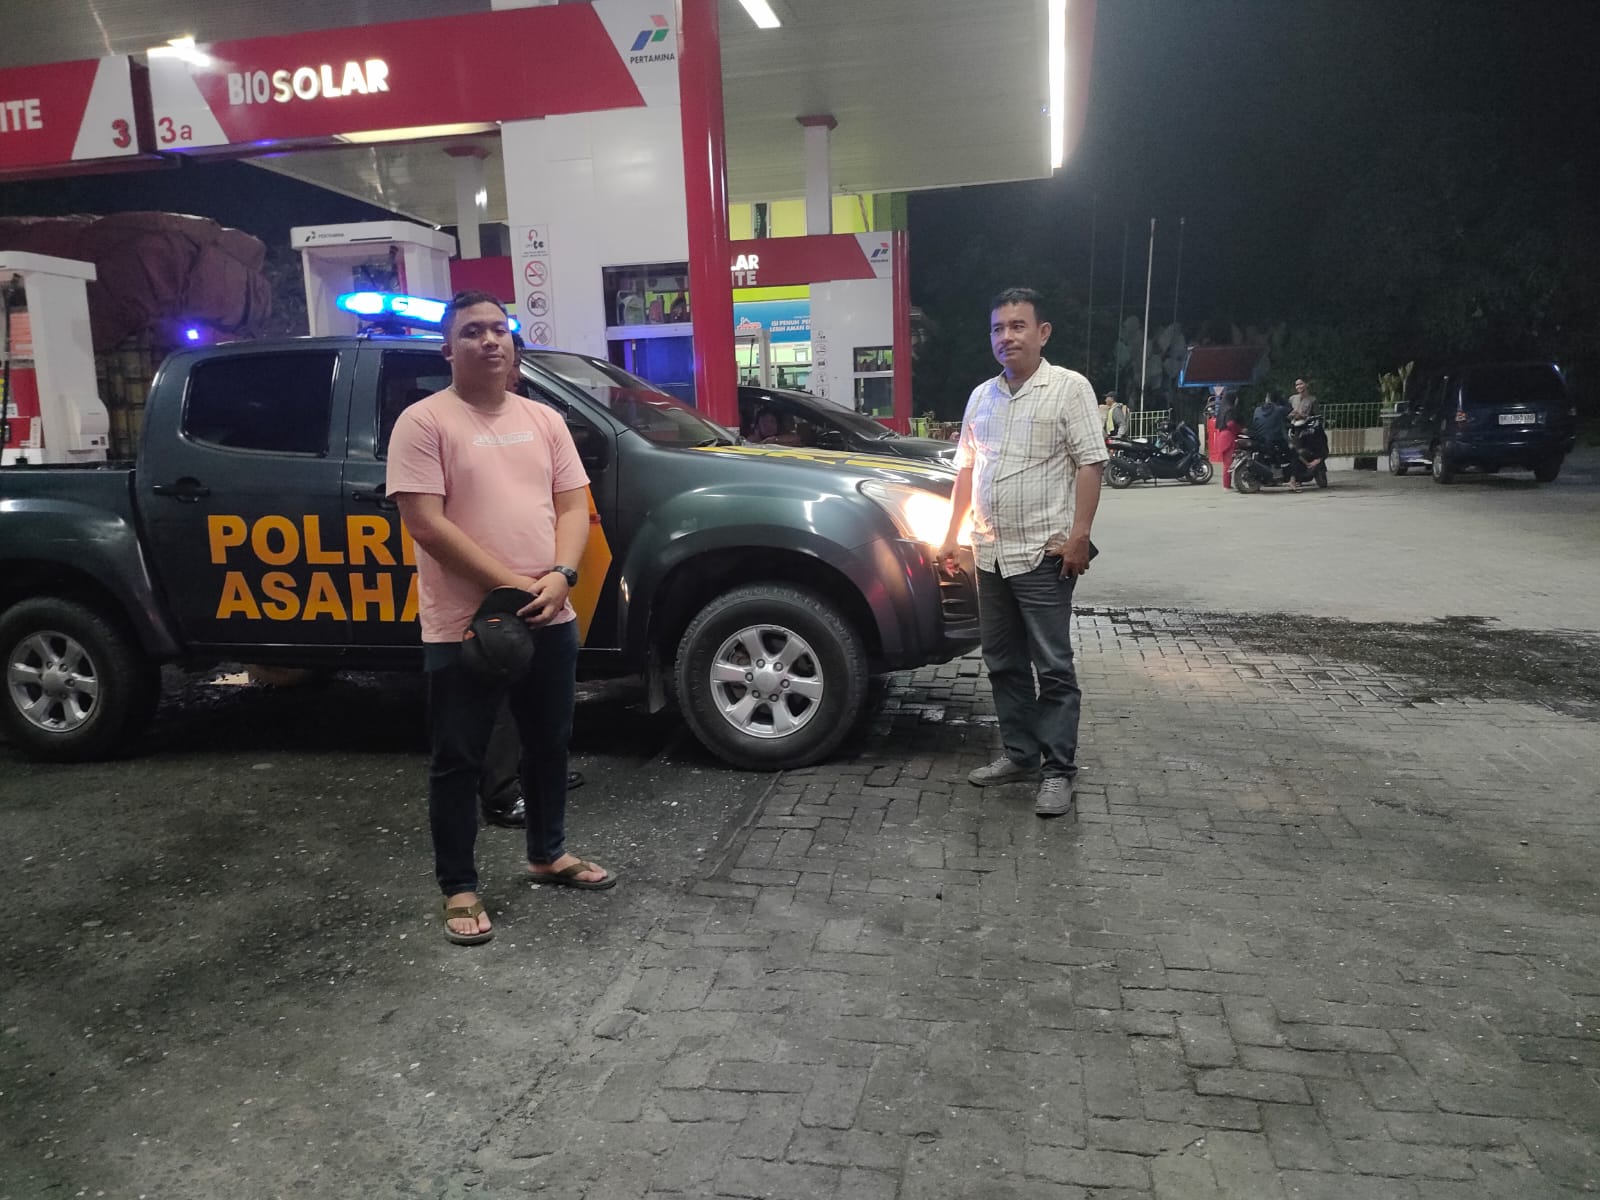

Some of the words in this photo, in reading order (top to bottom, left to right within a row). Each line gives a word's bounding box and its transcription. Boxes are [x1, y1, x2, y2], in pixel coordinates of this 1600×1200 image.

[629, 53, 675, 64] PERTAMINA
[112, 119, 131, 148] 3
[158, 117, 193, 143] 3a
